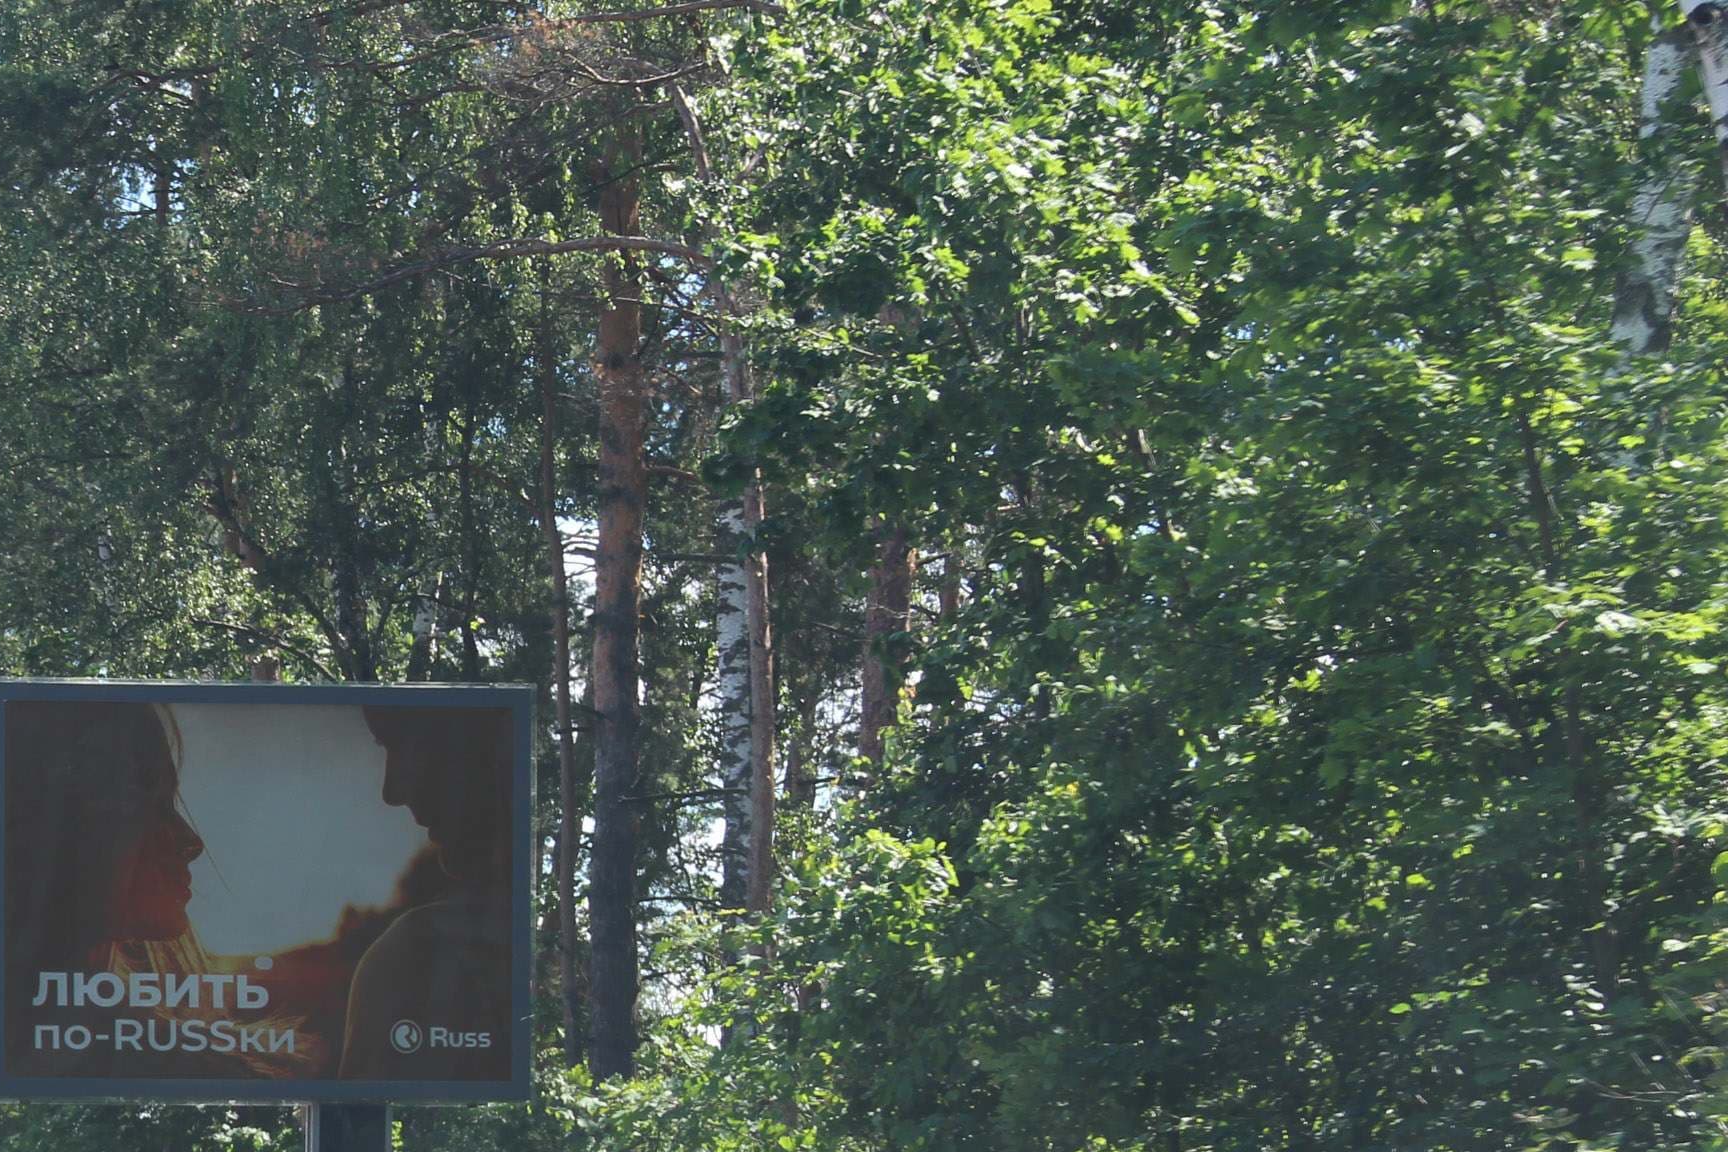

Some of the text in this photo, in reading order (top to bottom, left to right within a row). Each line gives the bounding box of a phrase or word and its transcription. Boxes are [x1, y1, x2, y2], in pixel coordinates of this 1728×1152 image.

[32, 971, 270, 1010] ЛЮБИТЬ
[33, 1018, 296, 1054] по-RUSSки
[430, 1026, 492, 1049] Russ
